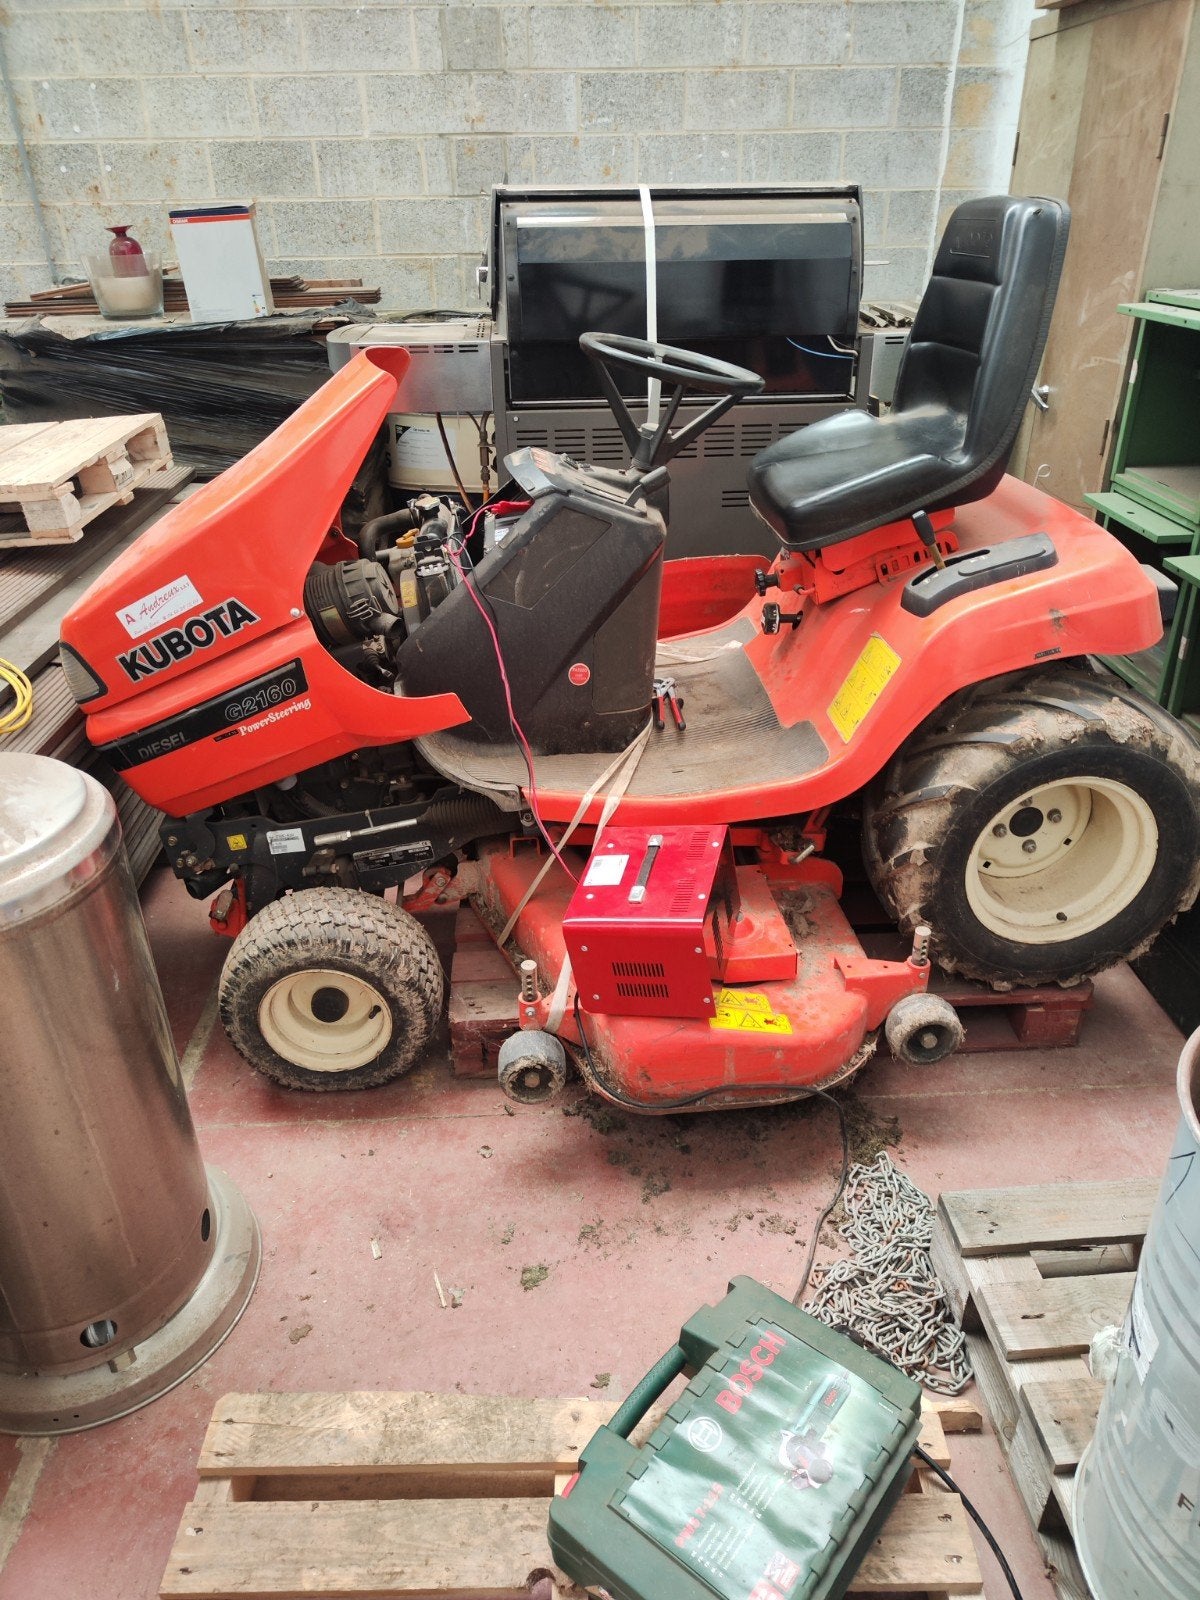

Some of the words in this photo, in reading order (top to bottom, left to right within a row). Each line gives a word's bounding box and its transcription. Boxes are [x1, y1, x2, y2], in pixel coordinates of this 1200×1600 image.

[117, 597, 261, 682] KUBOTA
[224, 678, 297, 722] G2160
[238, 698, 311, 737] PowerSteering
[137, 732, 188, 760] DIESEL
[716, 1329, 787, 1415] BOSCH
